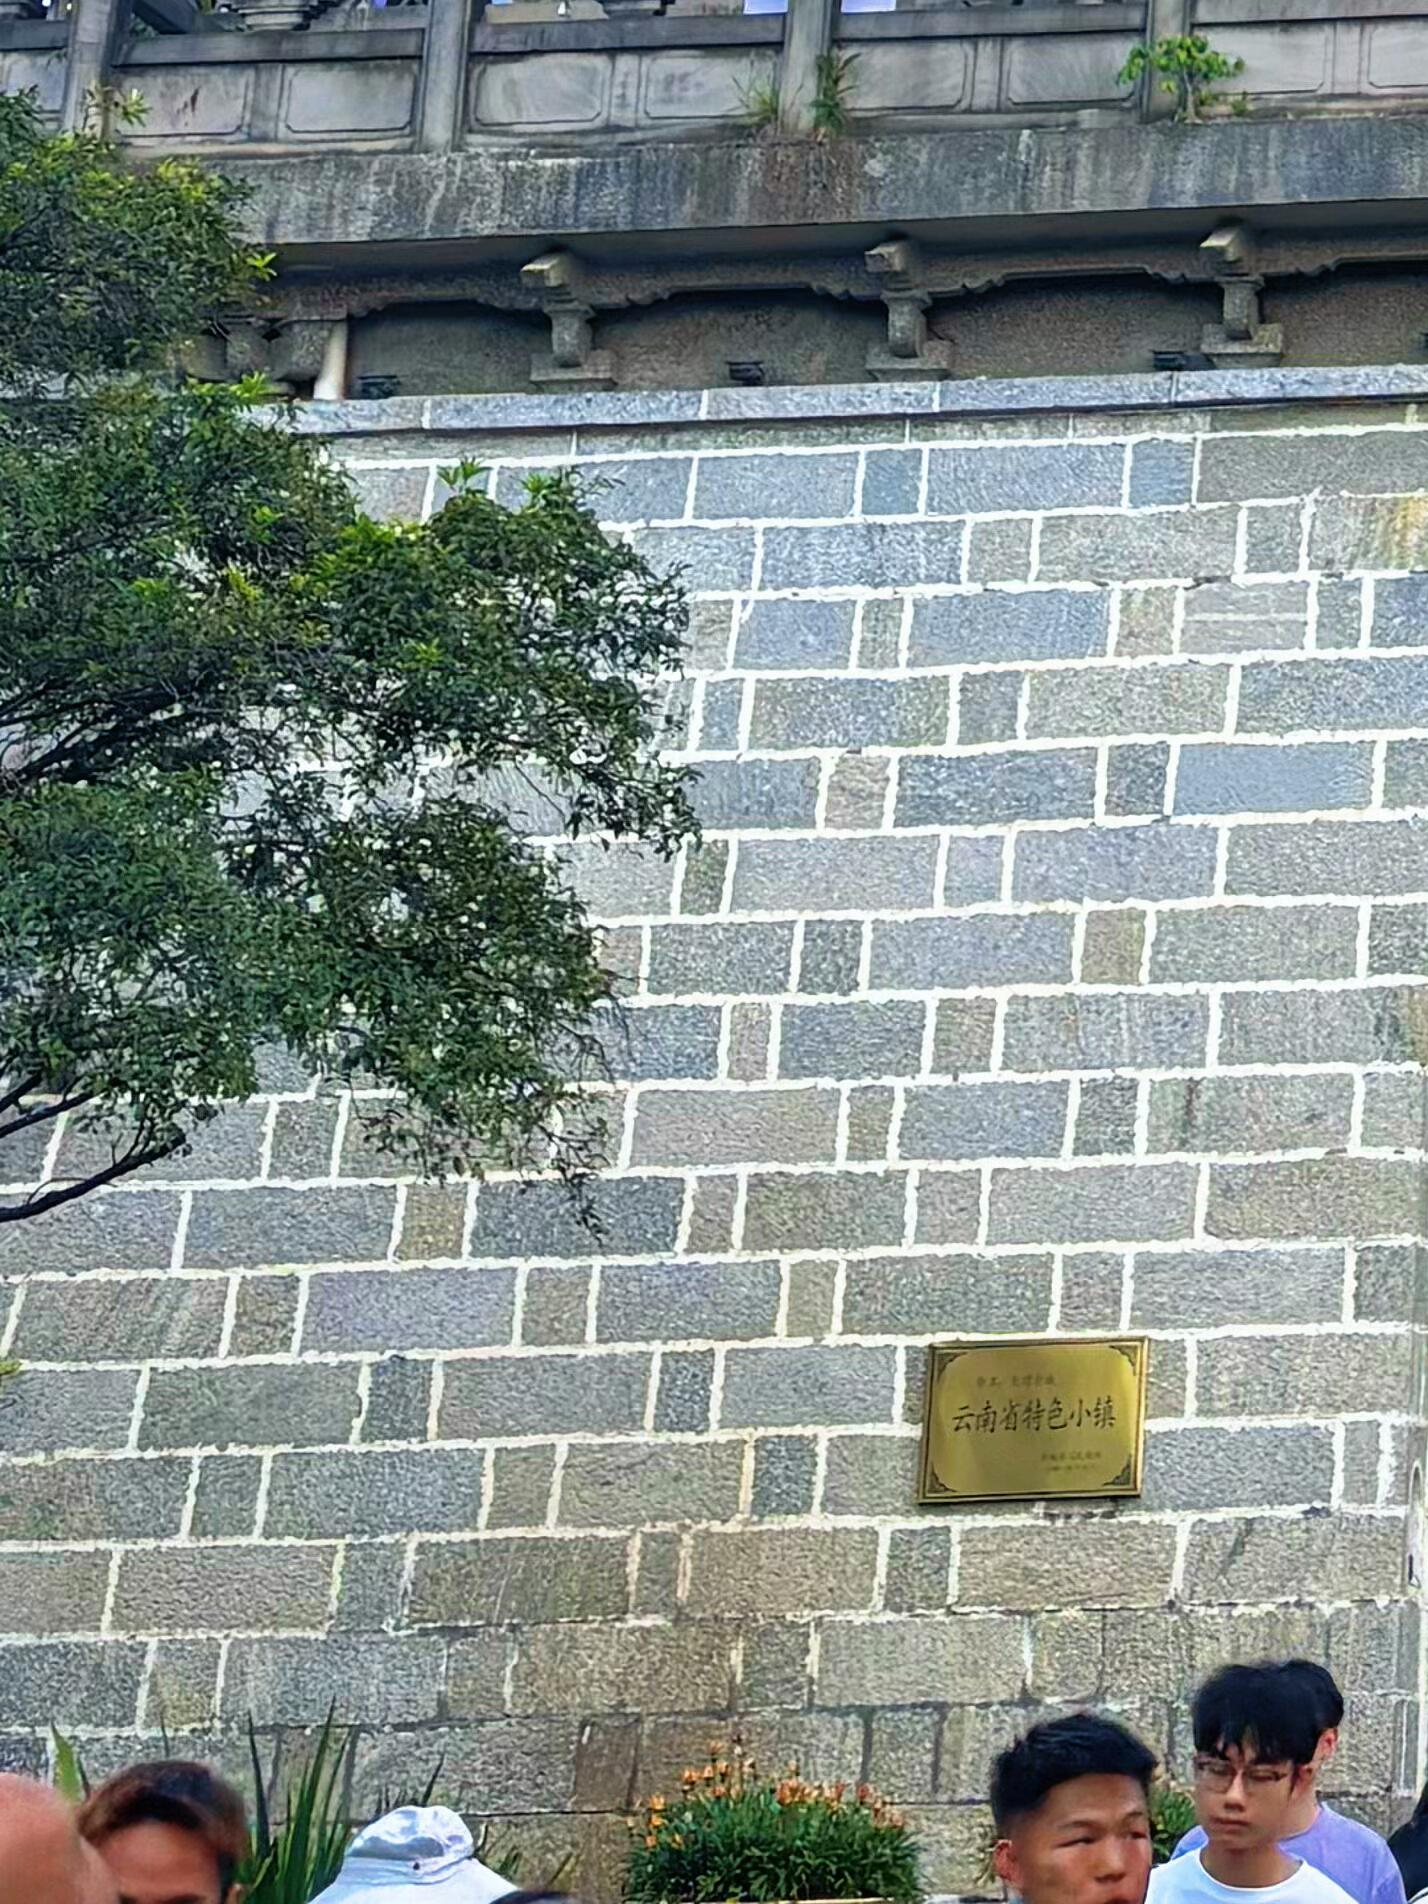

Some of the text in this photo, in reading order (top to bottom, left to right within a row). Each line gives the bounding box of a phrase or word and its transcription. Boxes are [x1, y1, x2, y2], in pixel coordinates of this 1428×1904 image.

[952, 1395, 1117, 1433] 云南省特色小镇
